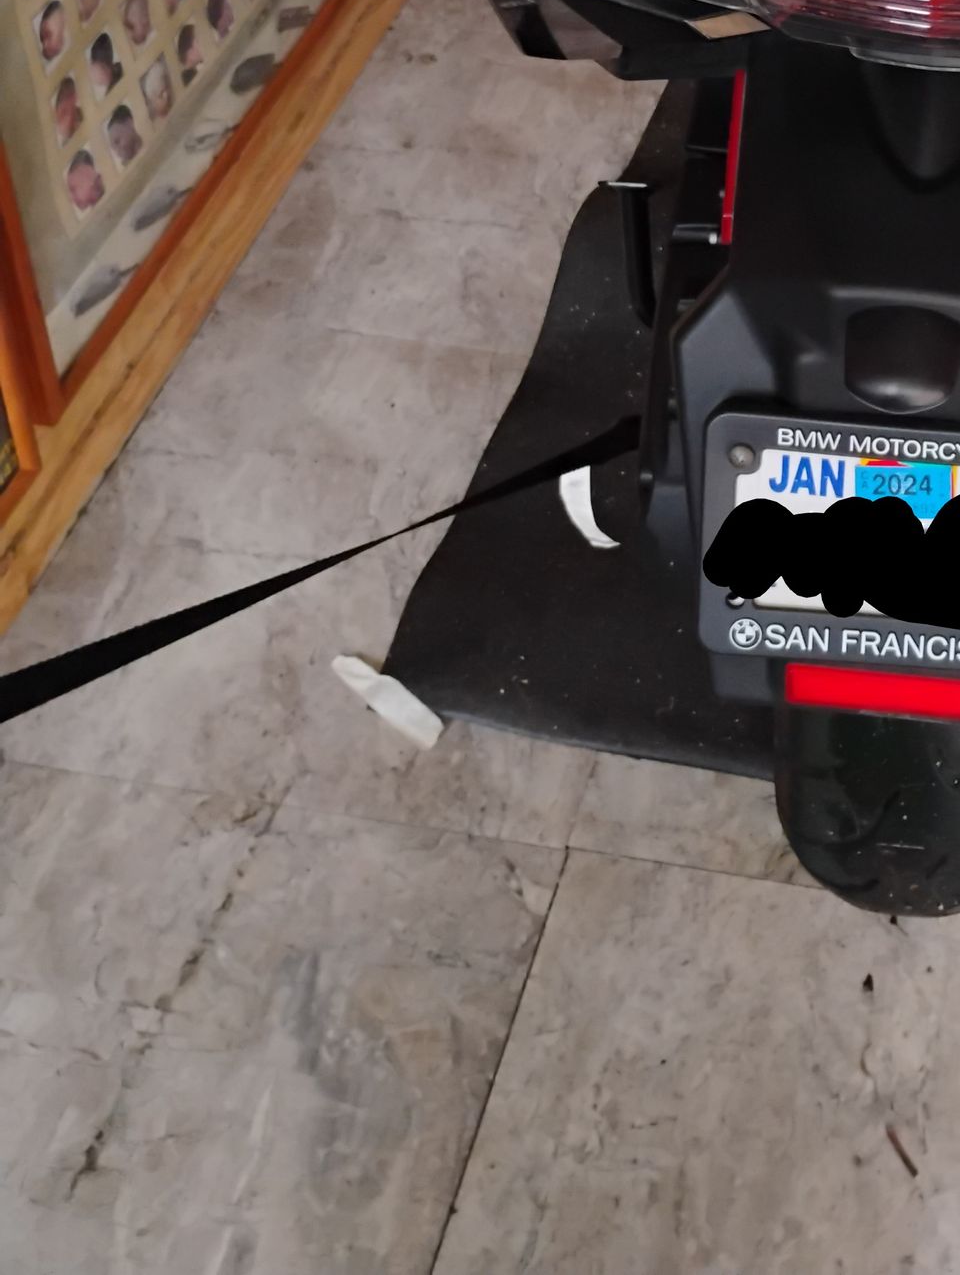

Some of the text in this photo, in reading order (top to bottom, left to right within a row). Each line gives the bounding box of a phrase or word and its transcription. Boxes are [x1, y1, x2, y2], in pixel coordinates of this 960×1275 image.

[777, 428, 842, 451] BMW
[768, 455, 846, 499] JAN
[872, 473, 933, 496] 2024
[764, 624, 830, 653] SAN
